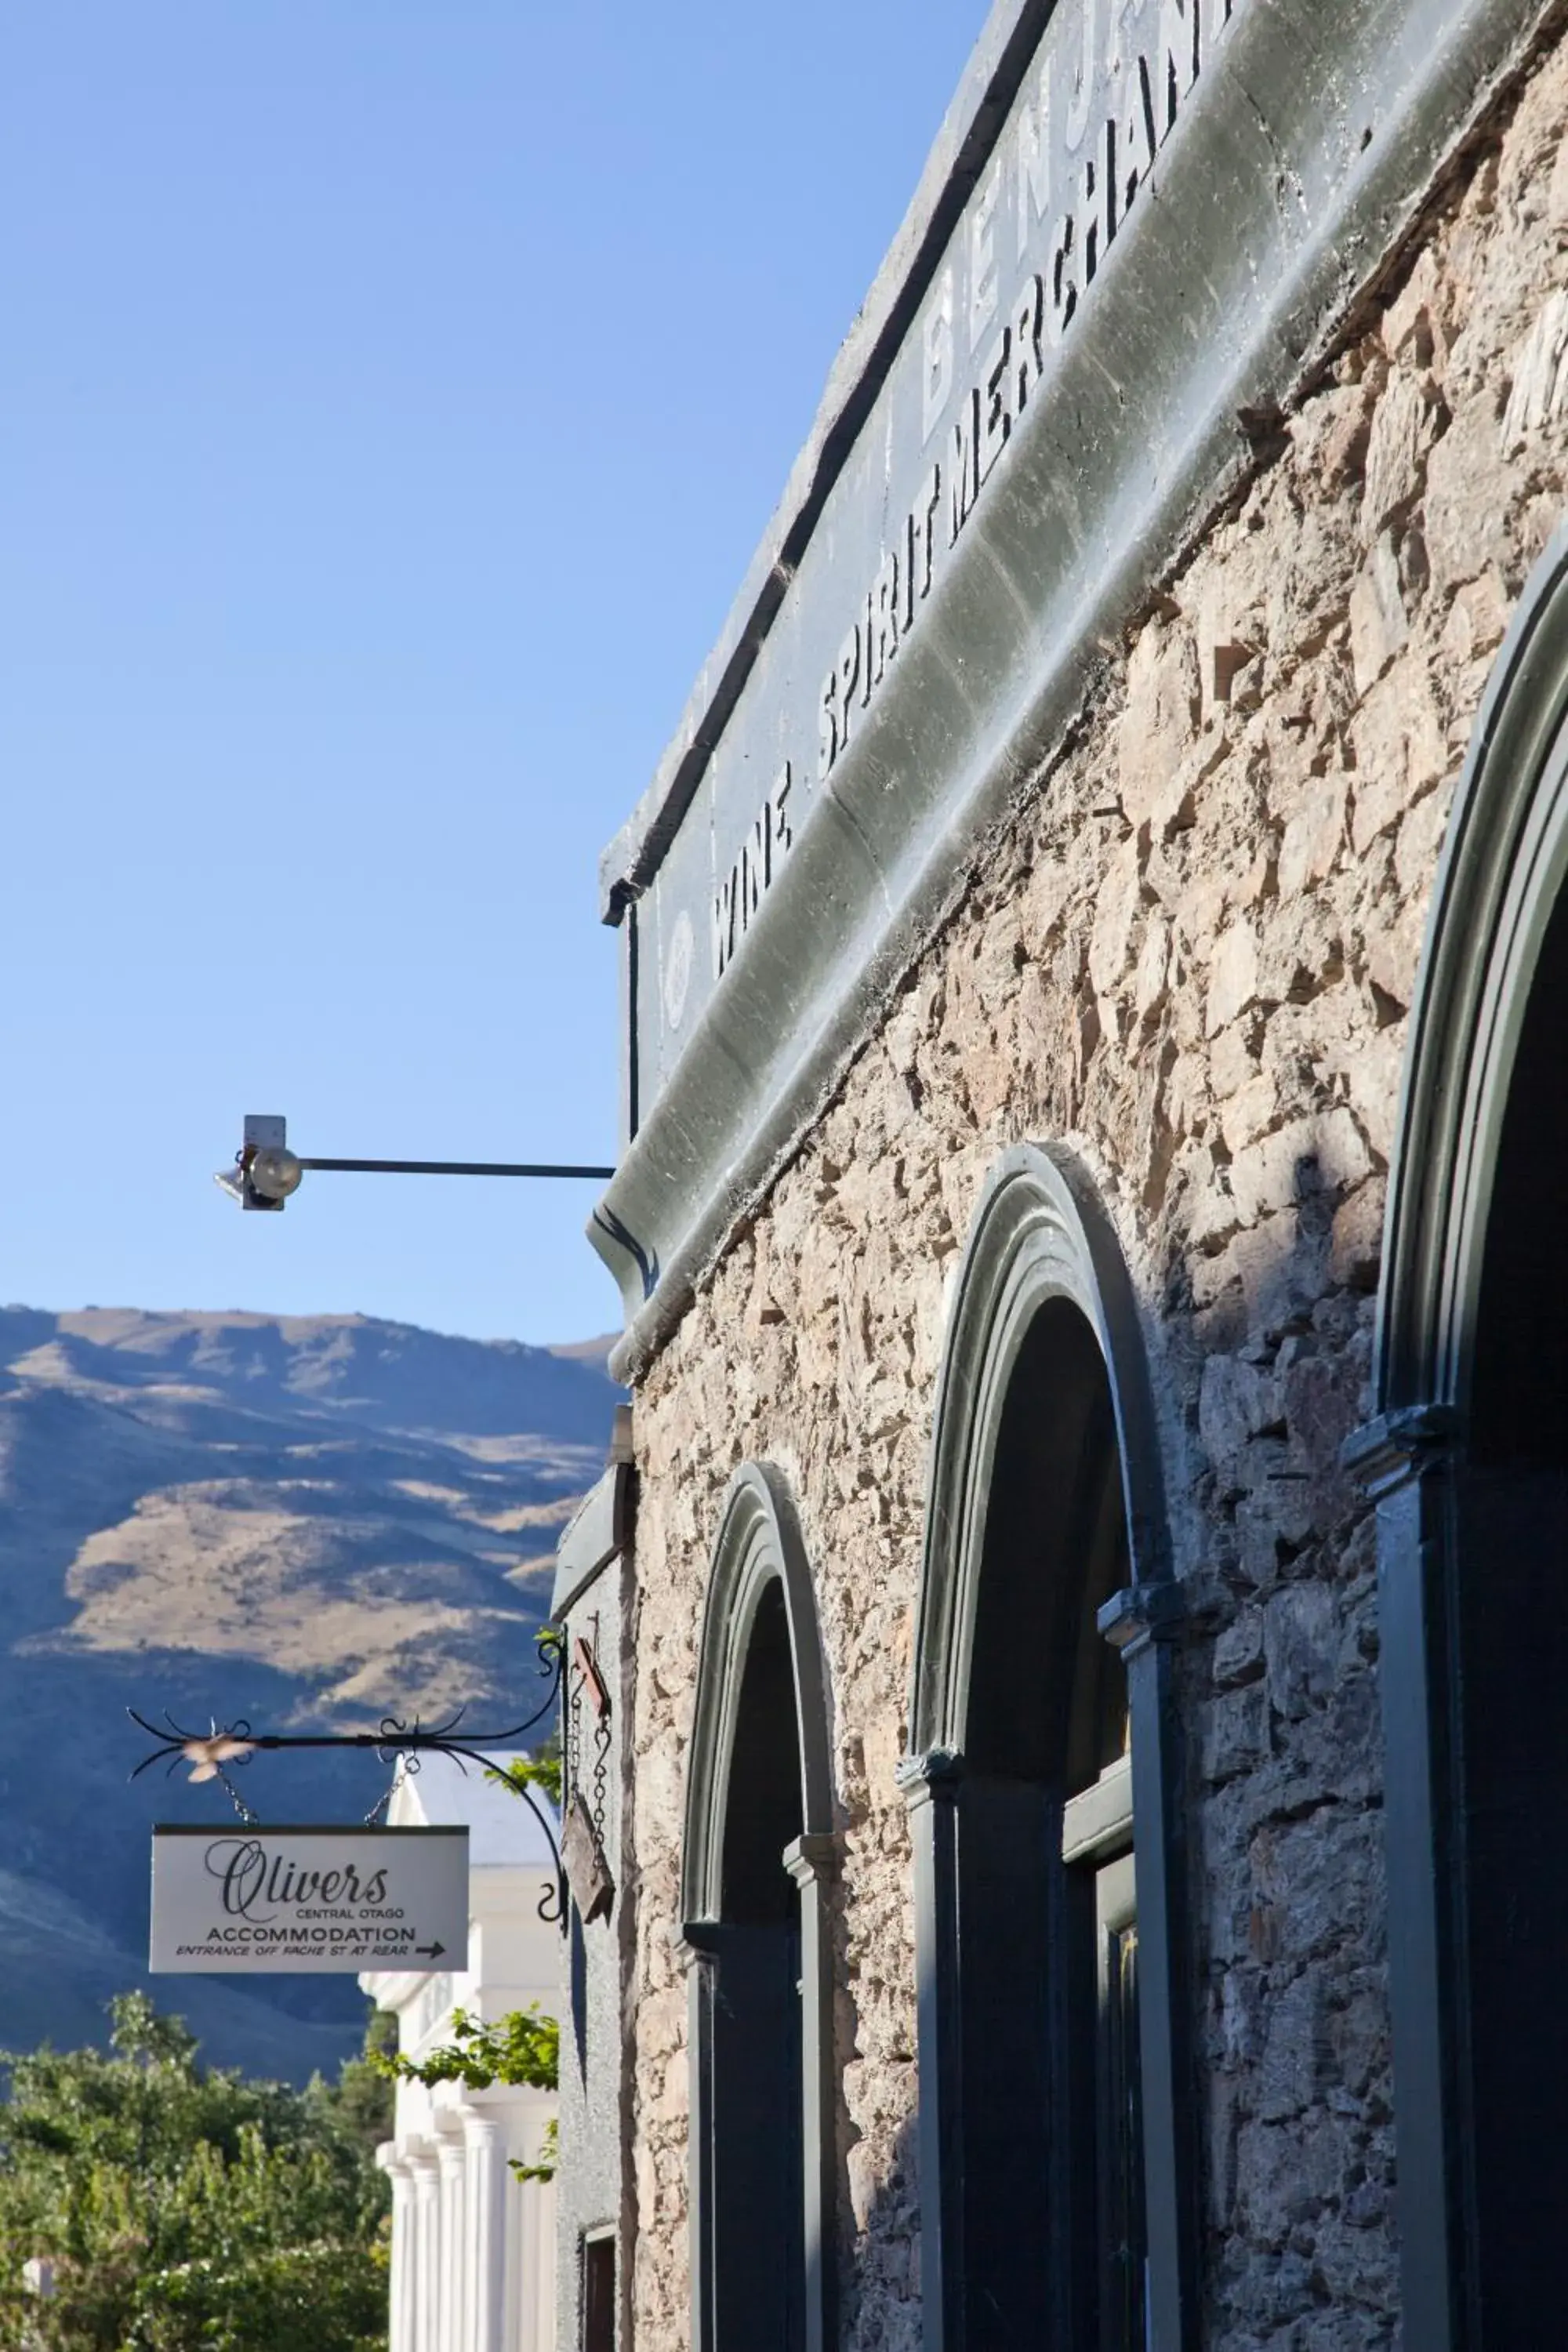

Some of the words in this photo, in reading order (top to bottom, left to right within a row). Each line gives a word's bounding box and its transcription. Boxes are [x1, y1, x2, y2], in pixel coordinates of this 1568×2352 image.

[710, 760, 791, 980] WINE
[818, 464, 941, 781] SPIRIT
[205, 1839, 388, 1923] Olivers
[296, 1909, 354, 1919] CENTRAL
[359, 1909, 405, 1918] OTAGO
[207, 1927, 416, 1942] ACCOMMODATION
[176, 1945, 249, 1956] ENTRANCE
[255, 1946, 279, 1956] OFF
[330, 1945, 347, 1955] ST
[350, 1945, 368, 1955] AT
[372, 1945, 408, 1956] REAR
